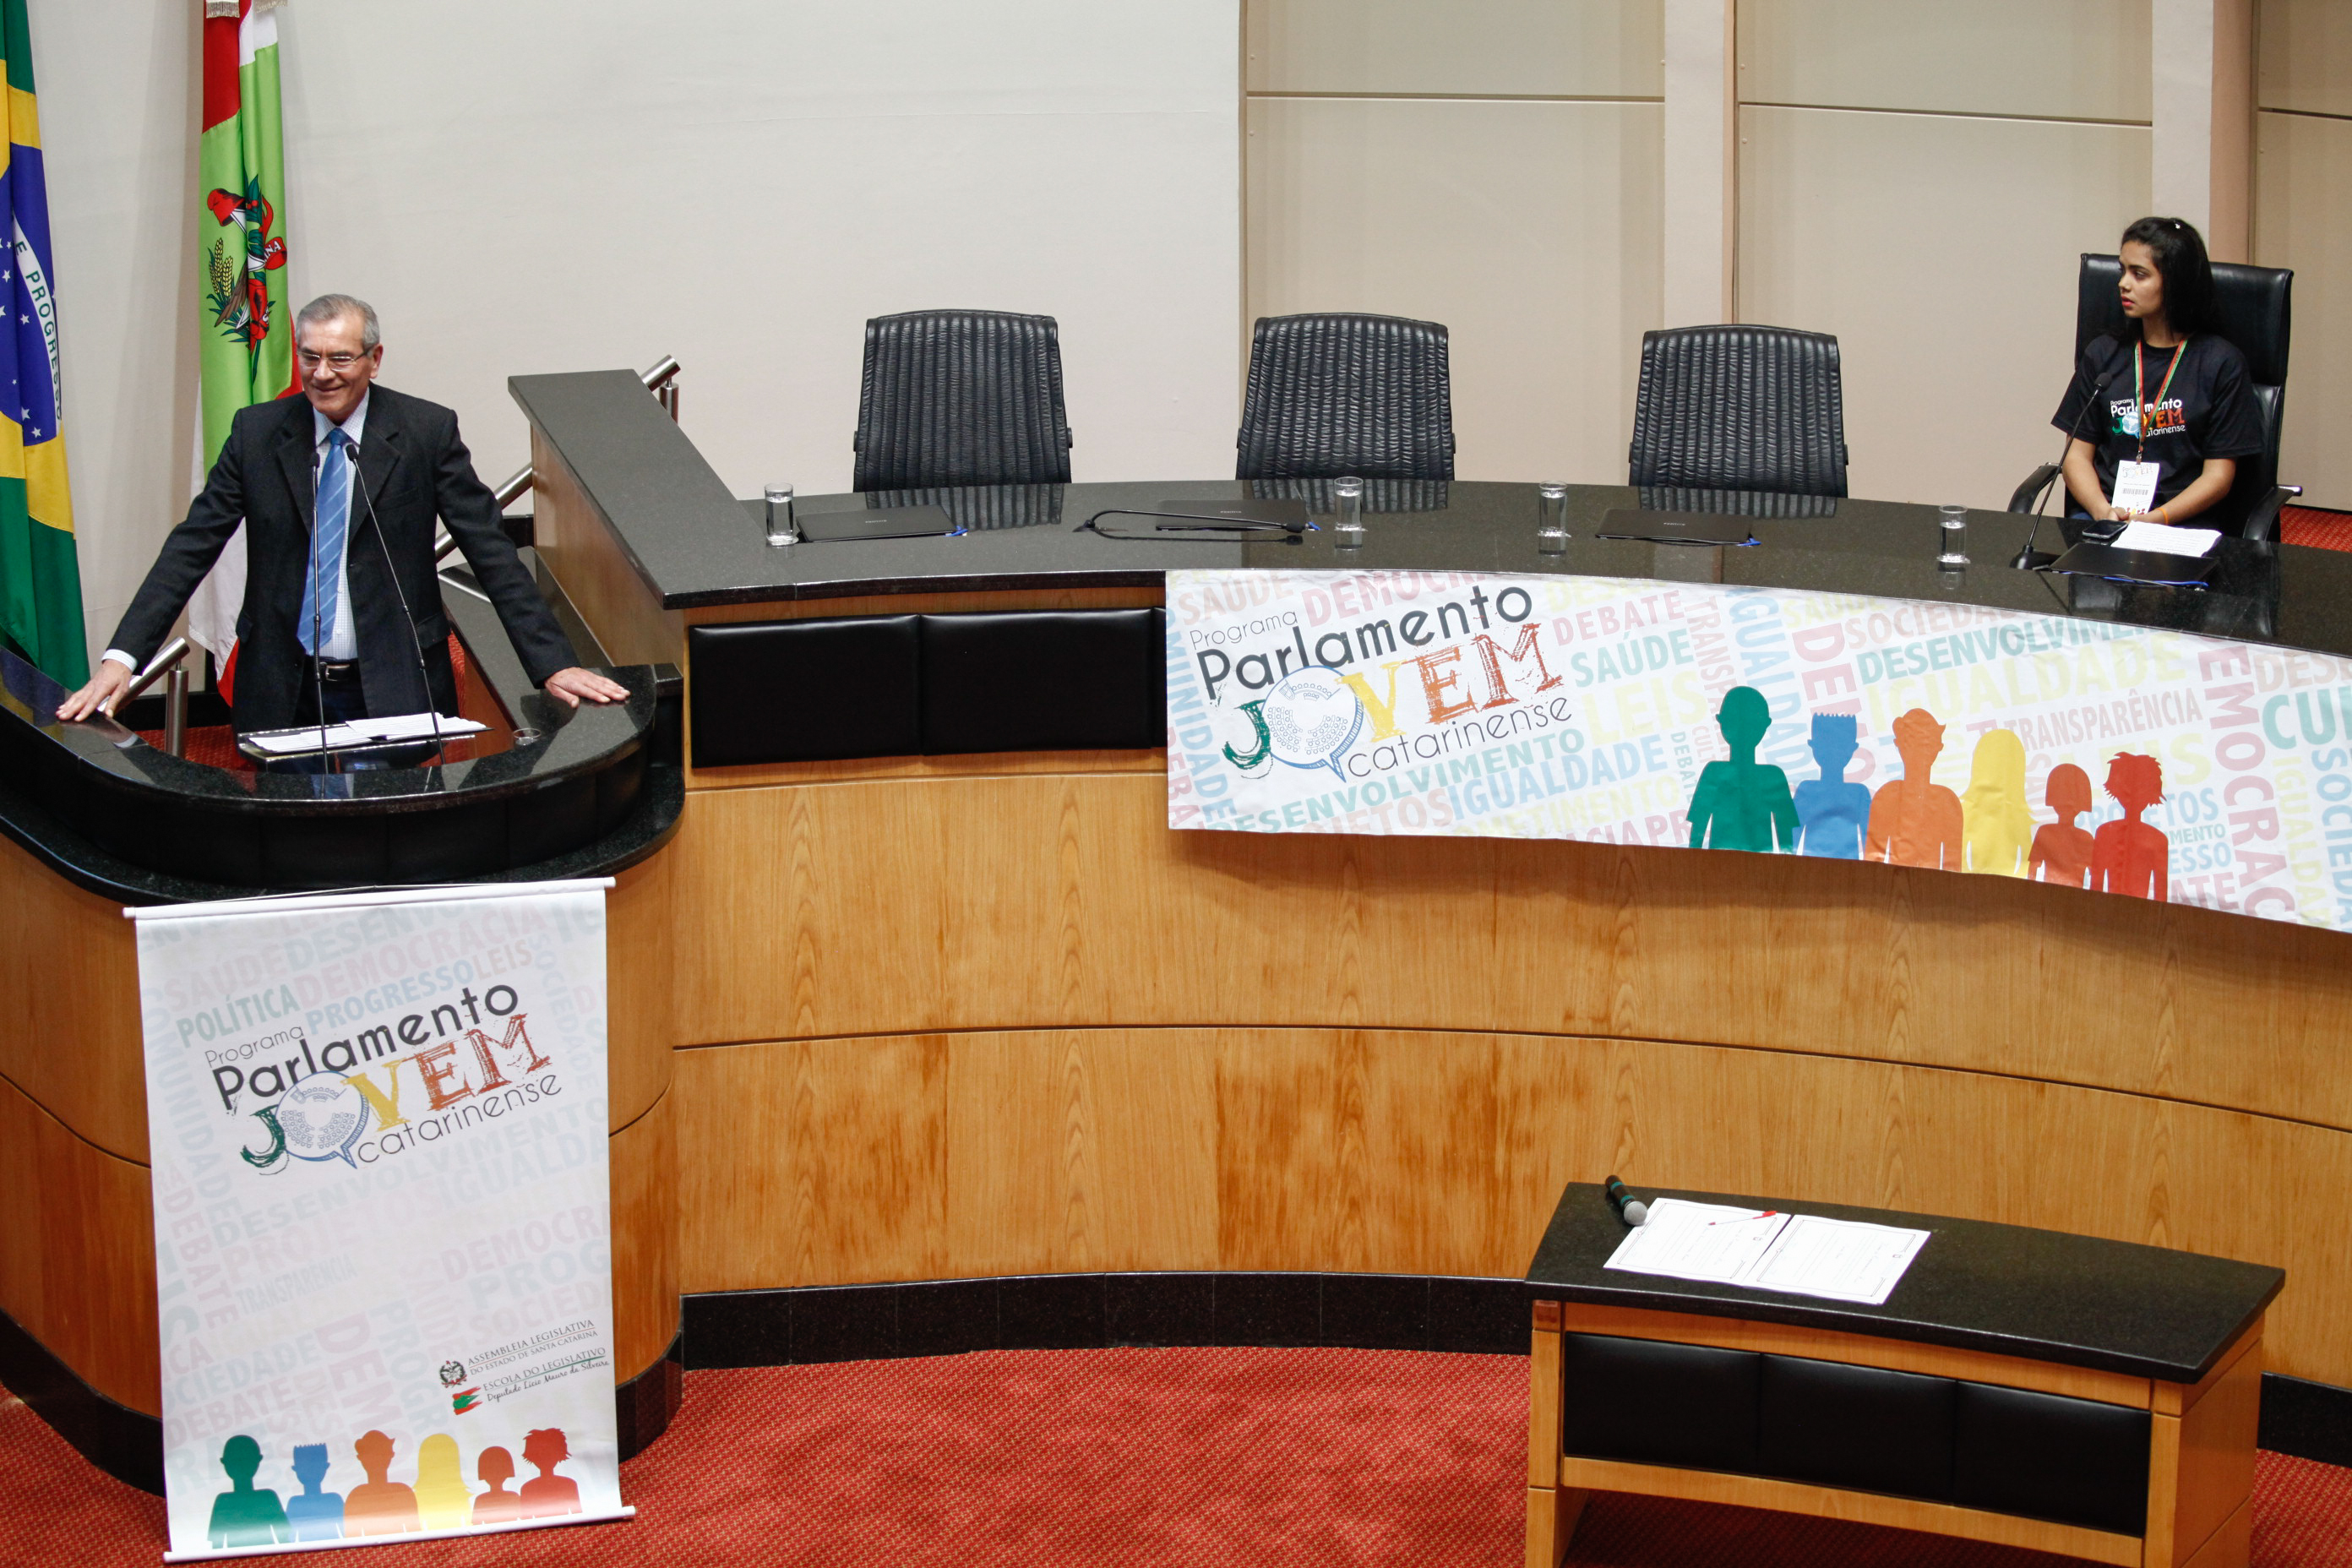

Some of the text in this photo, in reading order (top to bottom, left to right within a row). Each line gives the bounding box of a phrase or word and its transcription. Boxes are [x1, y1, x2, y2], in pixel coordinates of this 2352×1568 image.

[15, 241, 27, 256] E
[1190, 611, 1298, 651] Programa
[1196, 585, 1533, 700] Parlamento
[1552, 589, 1685, 646] DEBATE
[1571, 627, 1695, 688] SAÚDE
[1348, 697, 1572, 777] catarinense
[1582, 670, 1708, 747] LEIS
[2003, 688, 2203, 752] TRANSPARÊNCIA
[1446, 733, 1669, 821] IGUALDADE
[177, 984, 301, 1049] POLÍTICA
[293, 901, 547, 1010] DEMOCRACIA
[305, 939, 533, 1036] PROGRESSO LEIS
[204, 1026, 305, 1068] Programa
[211, 984, 520, 1112] Parlamento
[357, 1074, 564, 1164] catarinense
[213, 1097, 607, 1248] DESENVOLVIMENTO
[467, 1319, 595, 1367] ASSEMBLEIA LEGISLATIVA
[470, 1330, 599, 1376] DO ESTADO DE SANTA CATARINA
[482, 1346, 607, 1391] ESCOLA DO LEGISLATIVO
[166, 1376, 296, 1451] DEBATE
[487, 1385, 522, 1402] Deputado
[544, 1369, 568, 1385] Mauro
[569, 1364, 580, 1375] da
[581, 1358, 610, 1372] Silveira
